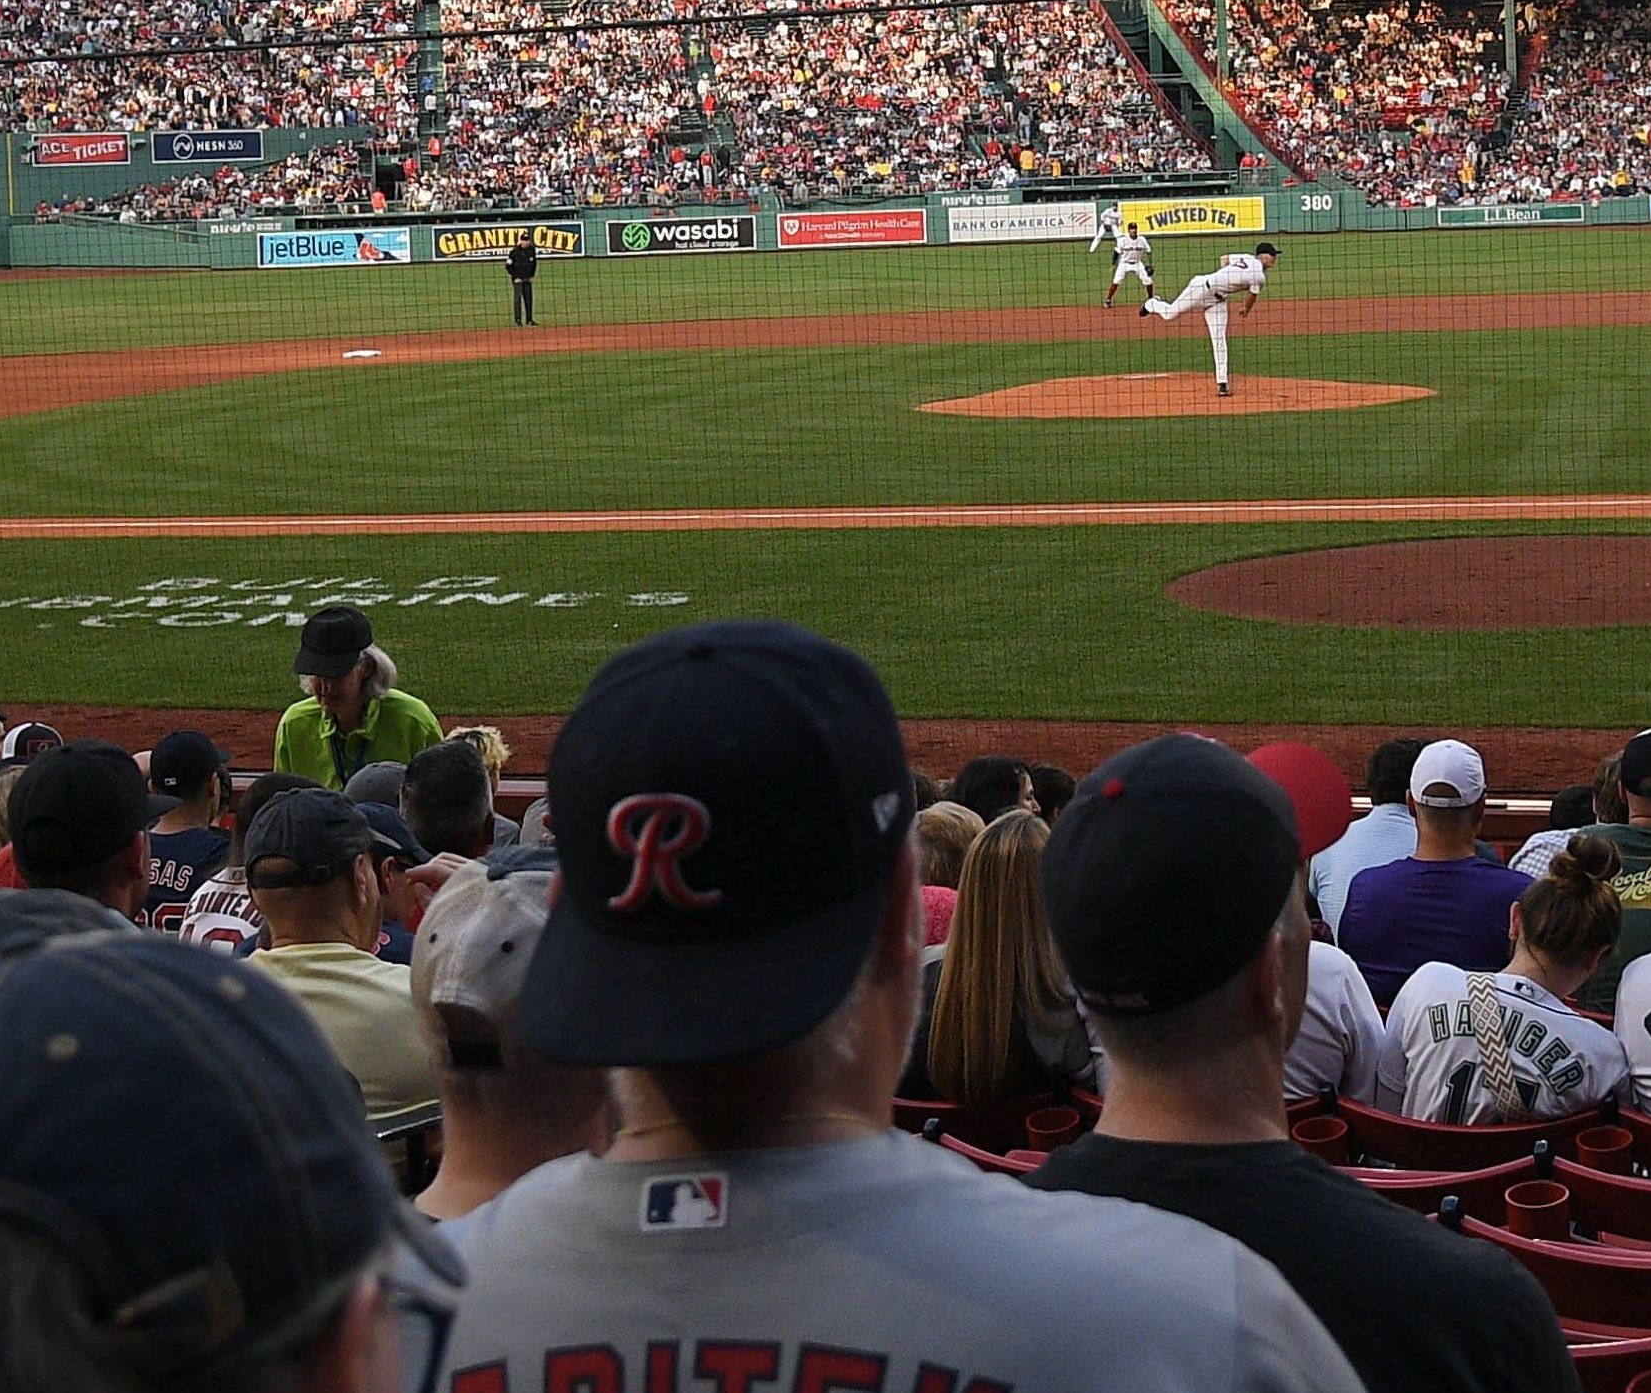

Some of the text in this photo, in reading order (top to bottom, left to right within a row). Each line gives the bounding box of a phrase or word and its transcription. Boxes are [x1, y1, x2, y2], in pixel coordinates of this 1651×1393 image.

[40, 139, 127, 160] ACE TICKET
[196, 139, 244, 152] NESN 360
[1300, 194, 1333, 212] 380
[801, 219, 837, 232] Harvard
[836, 218, 869, 234] Pilgrim
[869, 217, 900, 230] Health
[899, 217, 921, 229] Care
[952, 216, 1066, 232] BANK OF AMERICA
[1144, 208, 1238, 232] TWISTED TEA
[1483, 208, 1543, 222] L.L.Bean
[533, 225, 580, 252] CITY
[652, 219, 740, 242] wasabi
[268, 234, 345, 263] jetBlue
[605, 790, 725, 914] R
[1428, 1002, 1585, 1097] HAIGER
